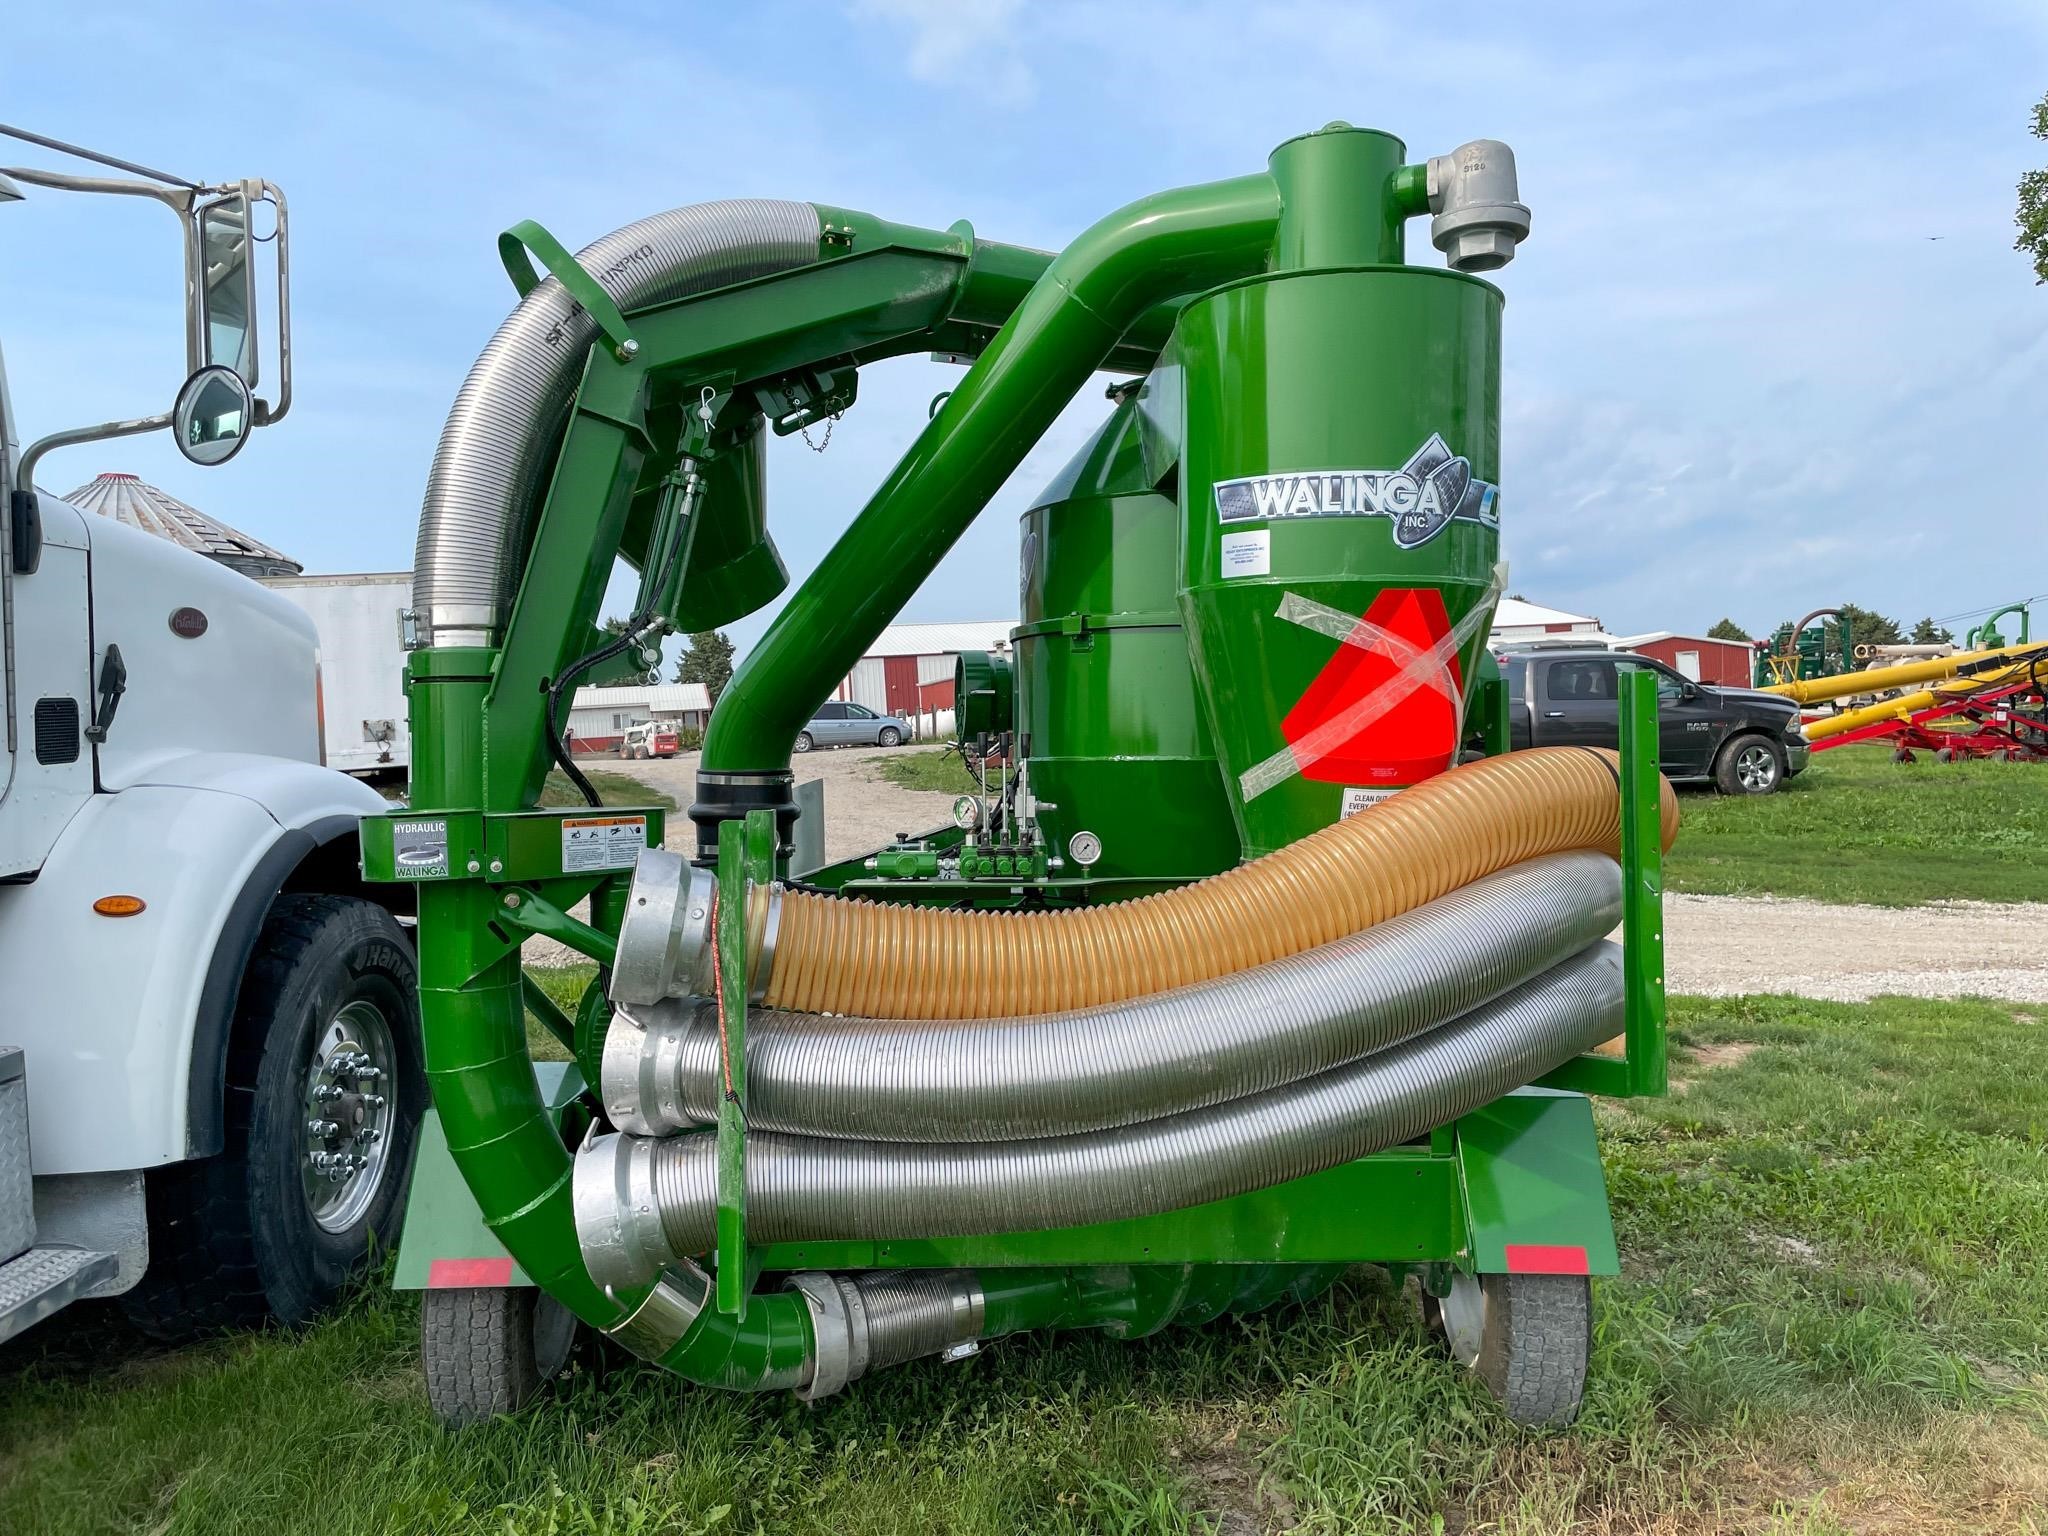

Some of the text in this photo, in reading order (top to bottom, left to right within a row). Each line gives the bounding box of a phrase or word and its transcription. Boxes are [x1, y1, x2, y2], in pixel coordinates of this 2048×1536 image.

[1252, 474, 1443, 517] WALINGA
[1405, 516, 1429, 528] INC.
[1354, 794, 1375, 802] CLEAN
[1349, 802, 1369, 811] EVERY
[394, 822, 445, 834] HYDRAULIC
[396, 866, 447, 877] WALINGA
